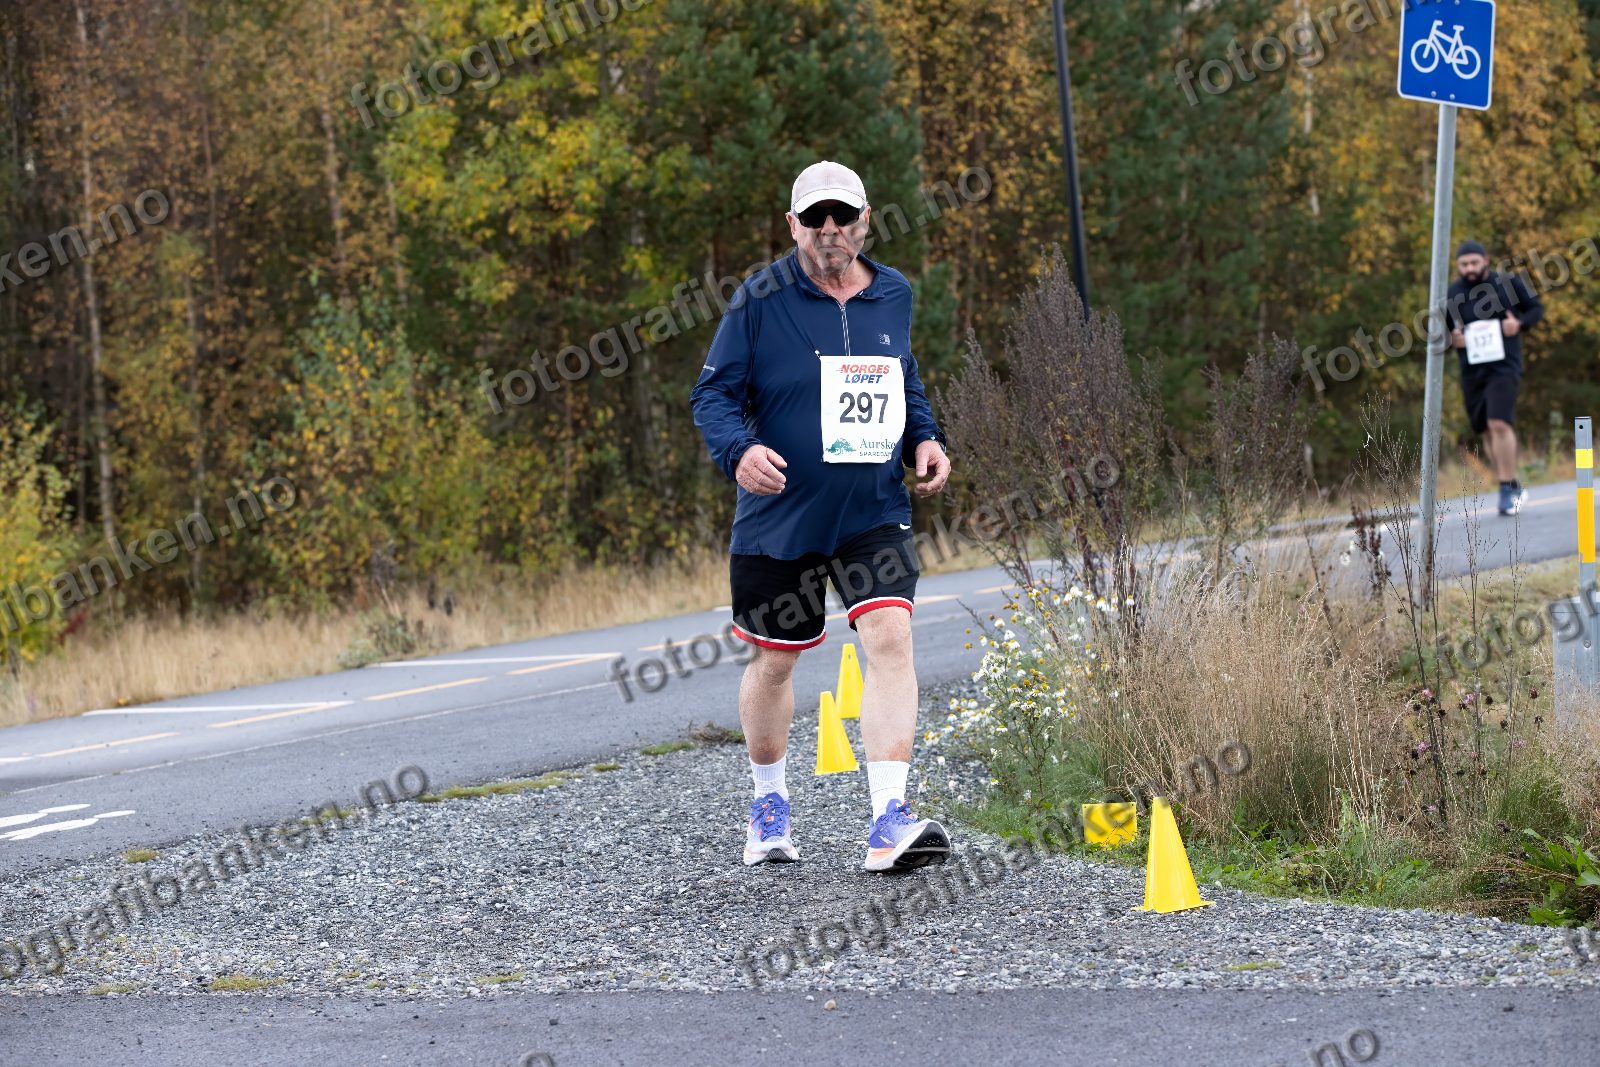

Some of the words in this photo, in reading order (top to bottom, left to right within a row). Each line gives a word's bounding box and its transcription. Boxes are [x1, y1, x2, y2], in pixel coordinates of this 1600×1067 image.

[840, 364, 891, 375] NORGES
[845, 374, 883, 384] LØPET
[839, 391, 889, 424] 297
